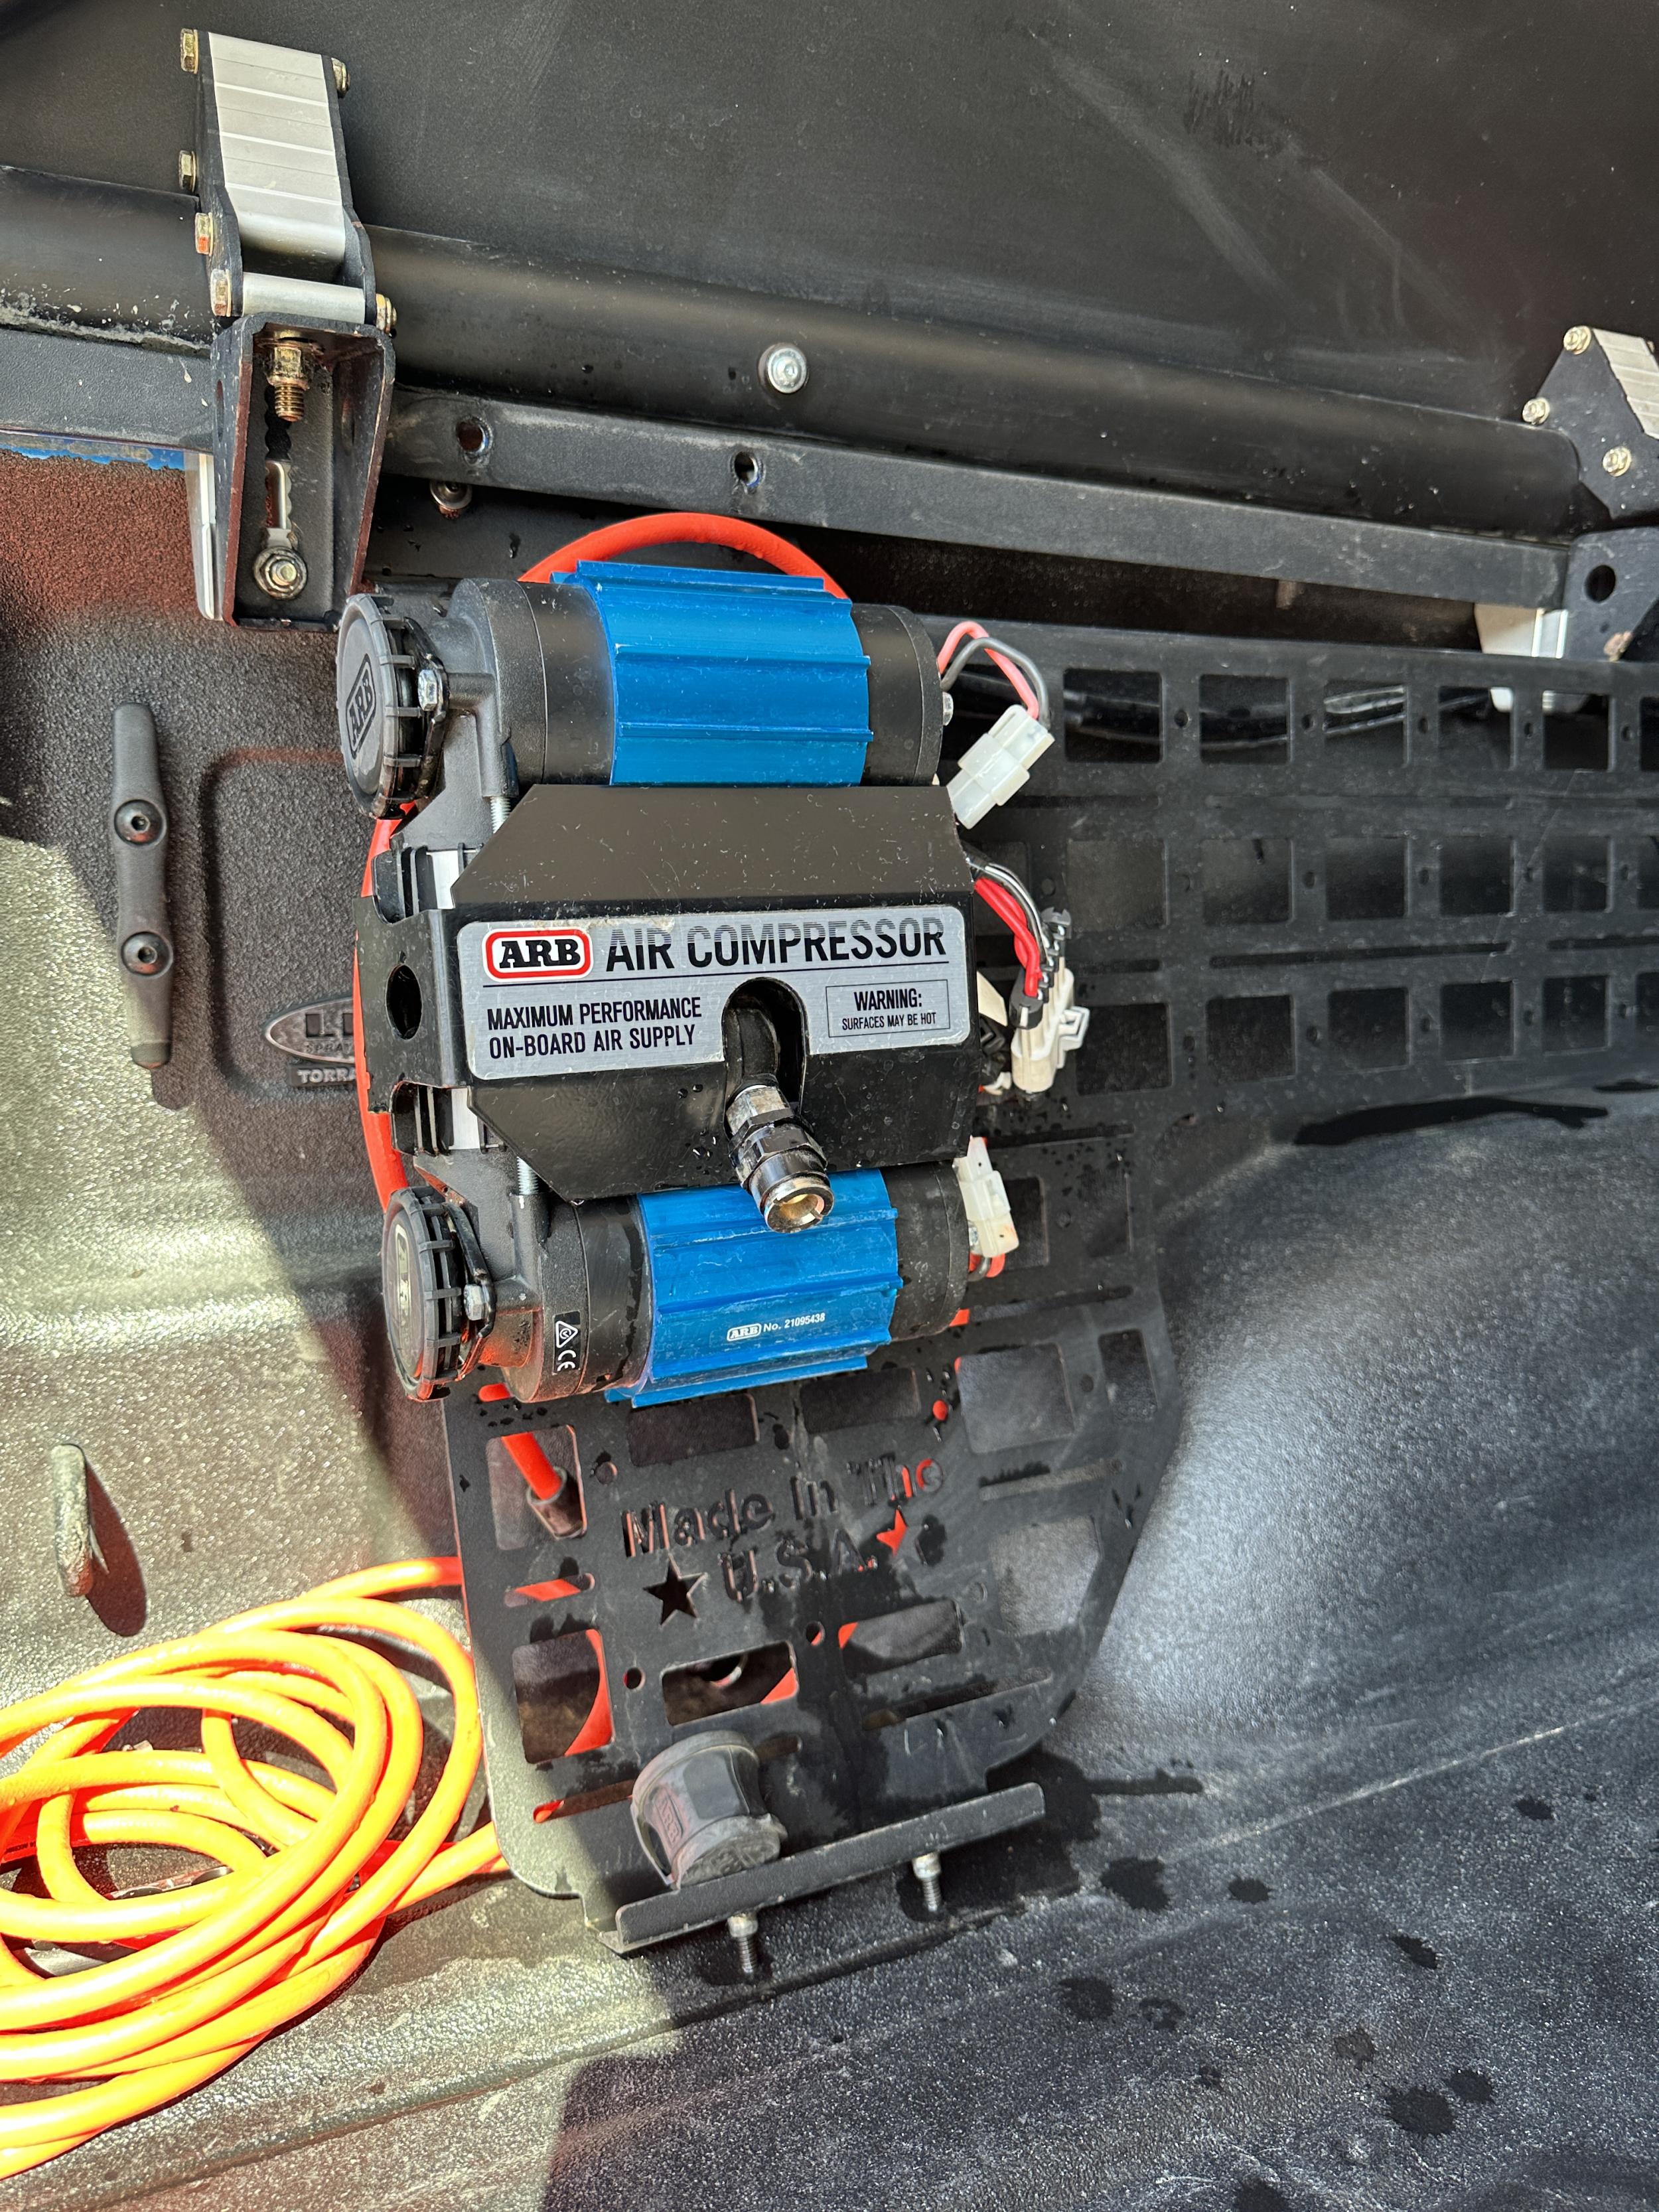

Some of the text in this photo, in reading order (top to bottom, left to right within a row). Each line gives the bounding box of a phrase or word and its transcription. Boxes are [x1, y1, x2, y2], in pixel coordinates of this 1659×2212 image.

[349, 668, 373, 744] ARB
[499, 938, 583, 969] ARB
[605, 917, 947, 972] AIR COMPRESSOR
[487, 997, 702, 1031] MAXIMUM PERFORMANCE
[853, 988, 923, 1011] WARNING:
[842, 1011, 937, 1030] SURFACES MAY BE HOT
[489, 1023, 695, 1060] ON-BOARD AIR SUPPLY
[731, 1313, 826, 1339] ARB No. 21095438
[621, 1488, 775, 1557] Made
